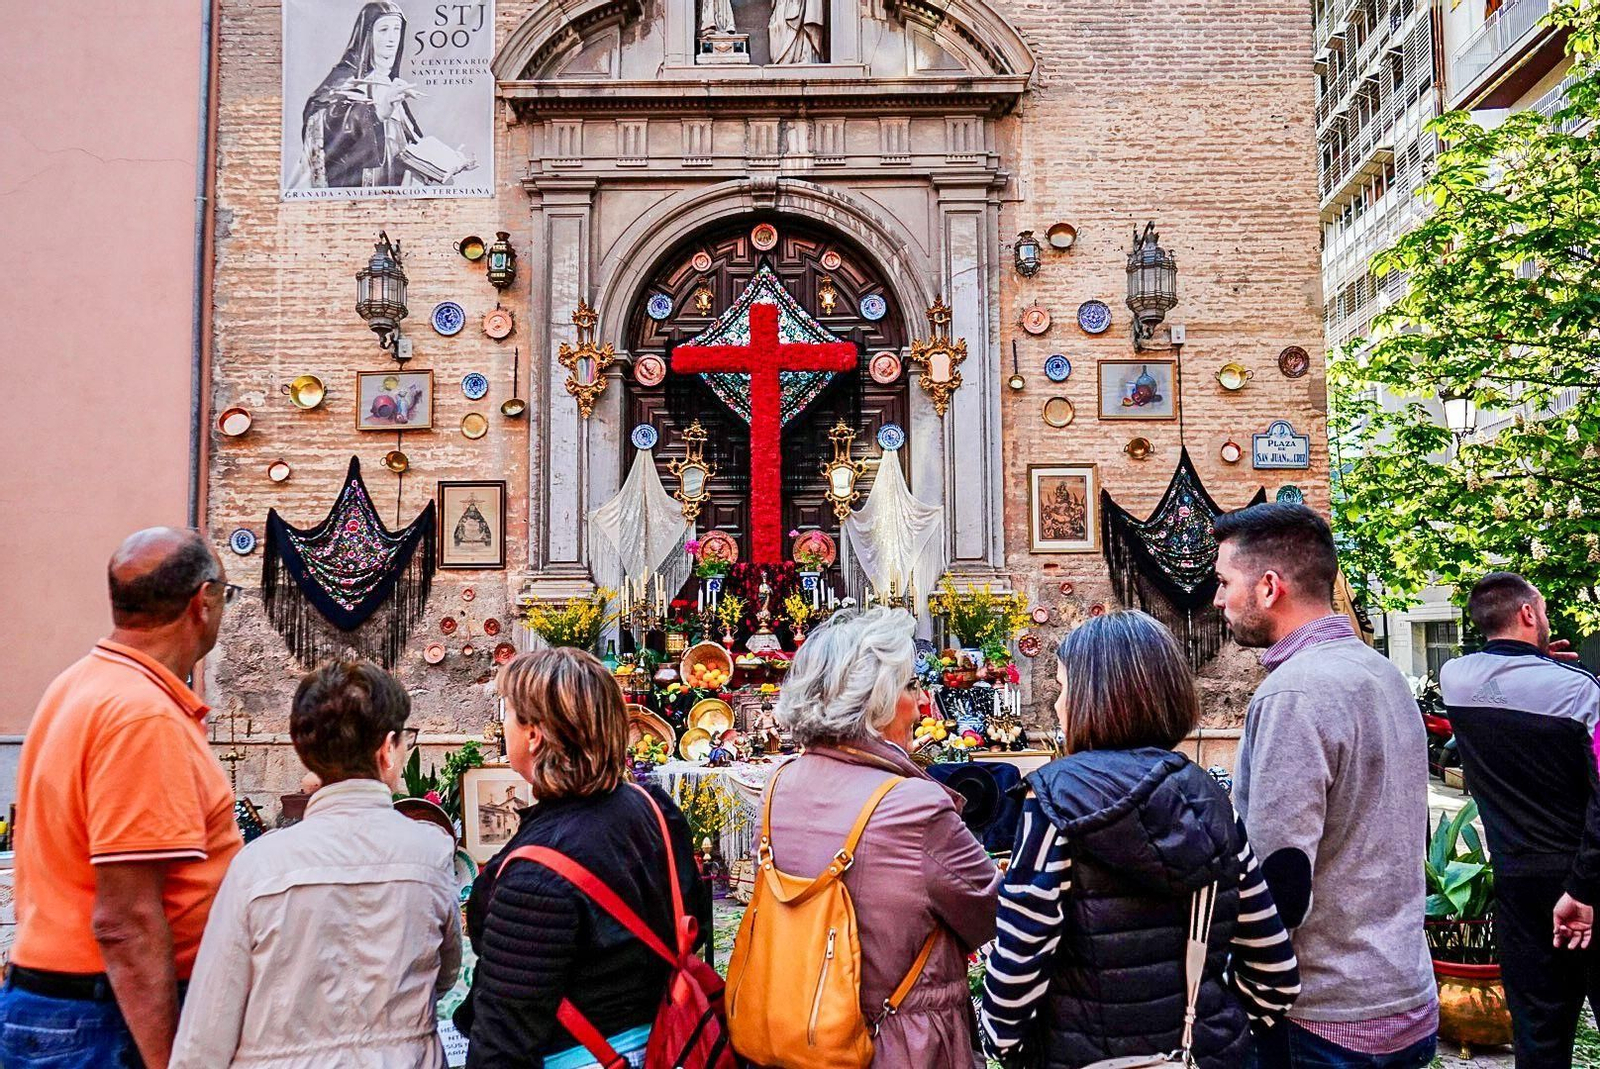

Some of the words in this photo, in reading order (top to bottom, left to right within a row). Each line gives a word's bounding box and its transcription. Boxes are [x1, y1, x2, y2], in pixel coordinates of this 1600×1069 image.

[434, 4, 486, 32] STJ
[414, 30, 470, 56] 500
[443, 76, 473, 84] JESÚS
[284, 191, 334, 199] GRANADA
[367, 188, 427, 196] FUNDACIÓN
[433, 187, 490, 195] TERESIANA
[1257, 453, 1268, 462] SAN
[1270, 453, 1286, 462] JUAN
[1294, 454, 1305, 462] CRUZ
